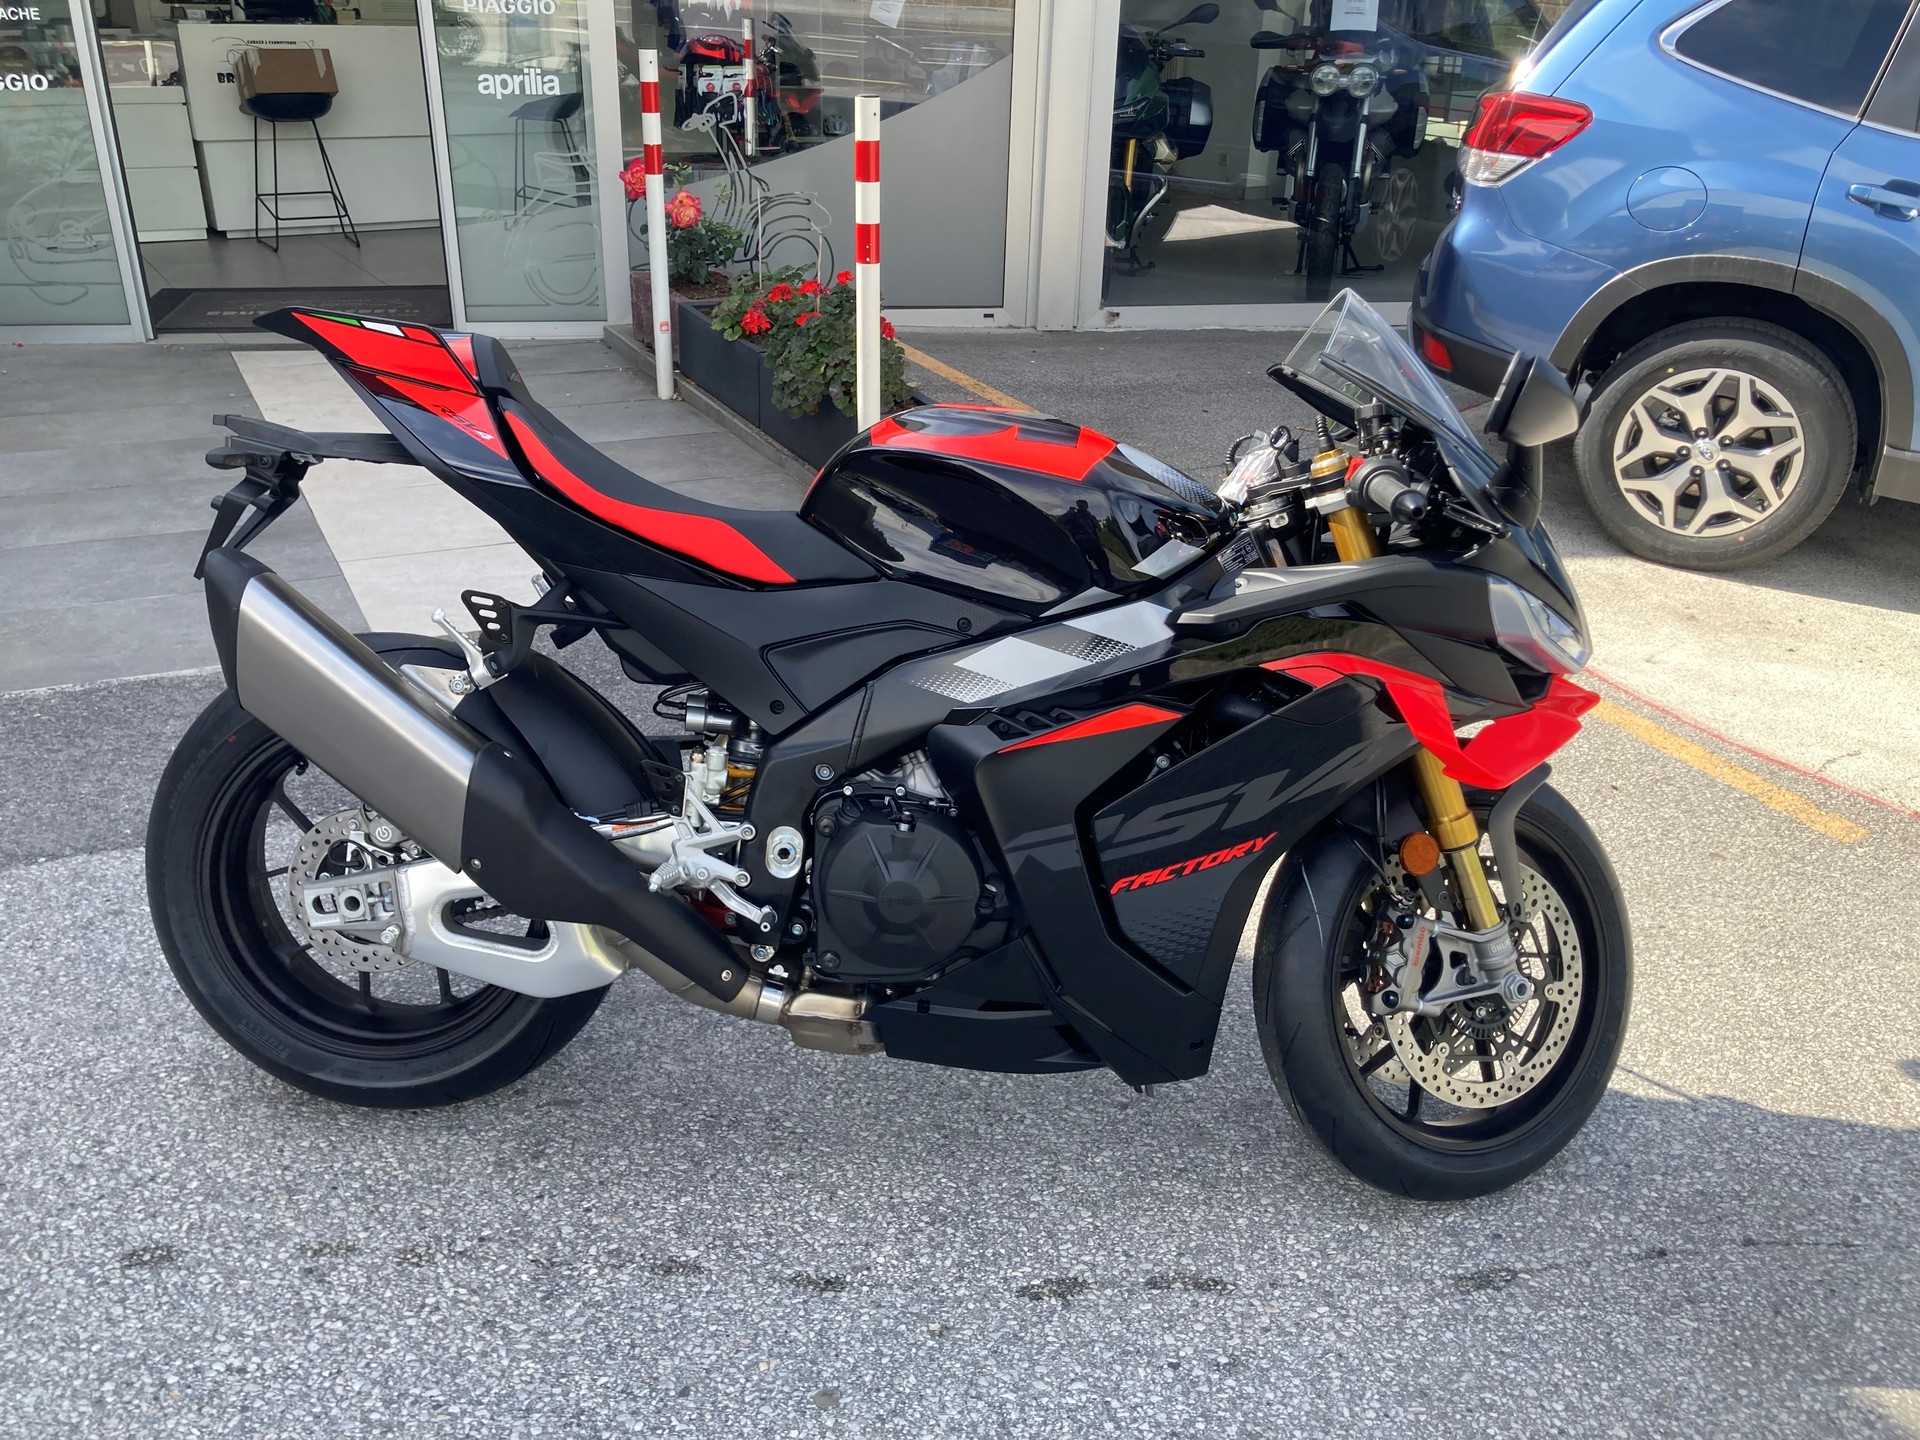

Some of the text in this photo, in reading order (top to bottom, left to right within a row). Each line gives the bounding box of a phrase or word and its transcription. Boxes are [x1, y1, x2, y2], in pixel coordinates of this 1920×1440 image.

[463, 0, 556, 14] PIAGGIO
[0, 73, 49, 91] GIO
[477, 68, 561, 99] aprilia
[1110, 831, 1279, 896] FACTORY
[1411, 926, 1426, 967] brembo
